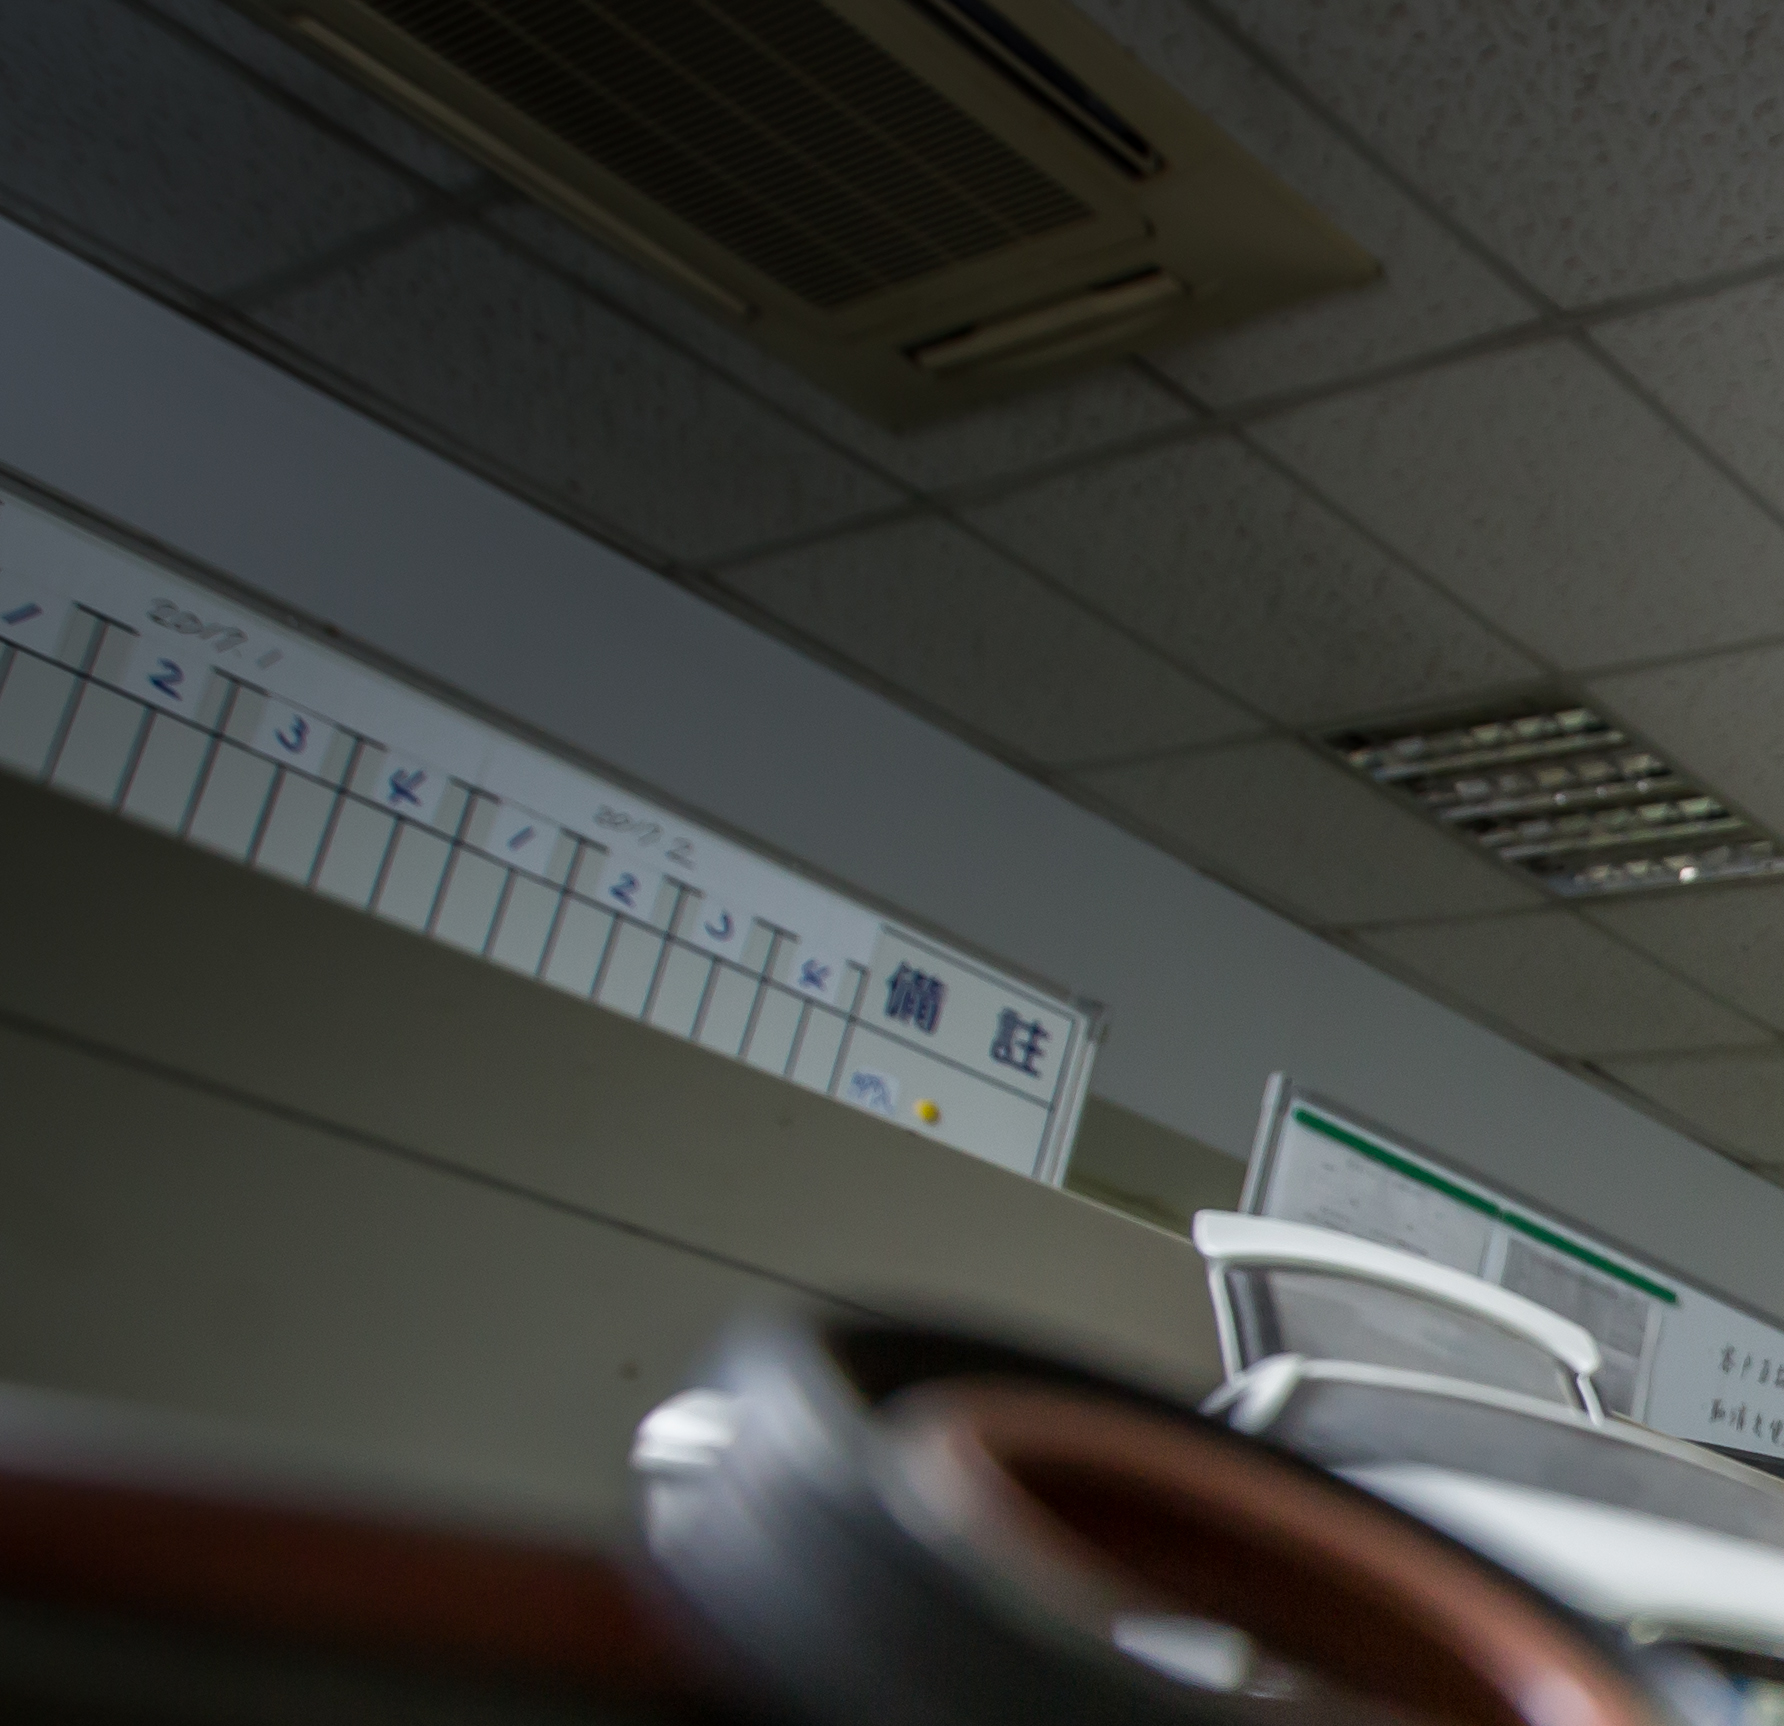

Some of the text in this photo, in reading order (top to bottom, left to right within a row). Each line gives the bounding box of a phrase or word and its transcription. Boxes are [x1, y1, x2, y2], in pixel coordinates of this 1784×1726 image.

[149, 657, 185, 701] 2
[275, 714, 310, 754] 3
[609, 872, 640, 908] 2
